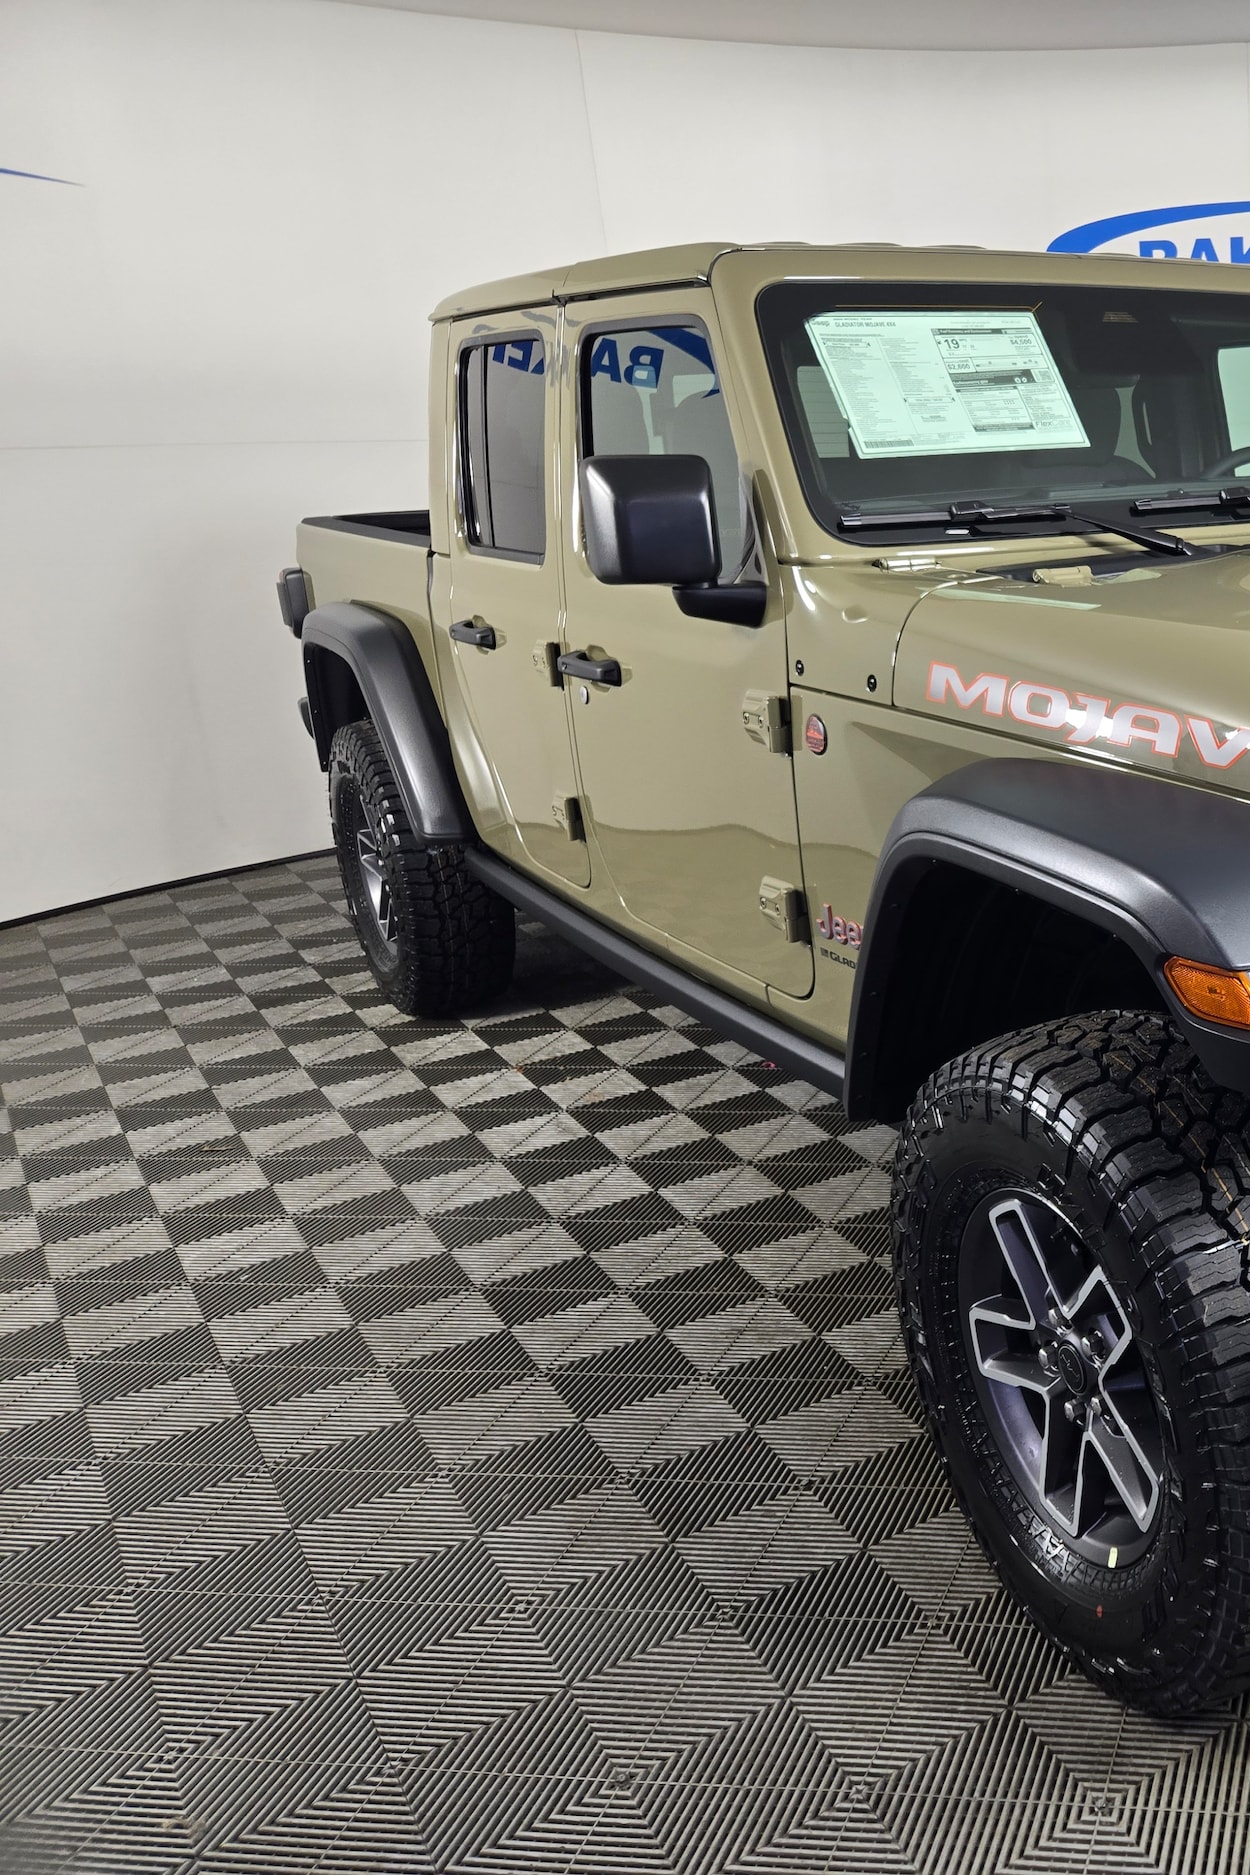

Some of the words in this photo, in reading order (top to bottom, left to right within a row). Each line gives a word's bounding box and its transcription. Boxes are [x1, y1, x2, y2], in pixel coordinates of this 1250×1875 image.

[944, 338, 960, 349] 19
[816, 902, 864, 950] Jee
[829, 951, 857, 970] GLAD
